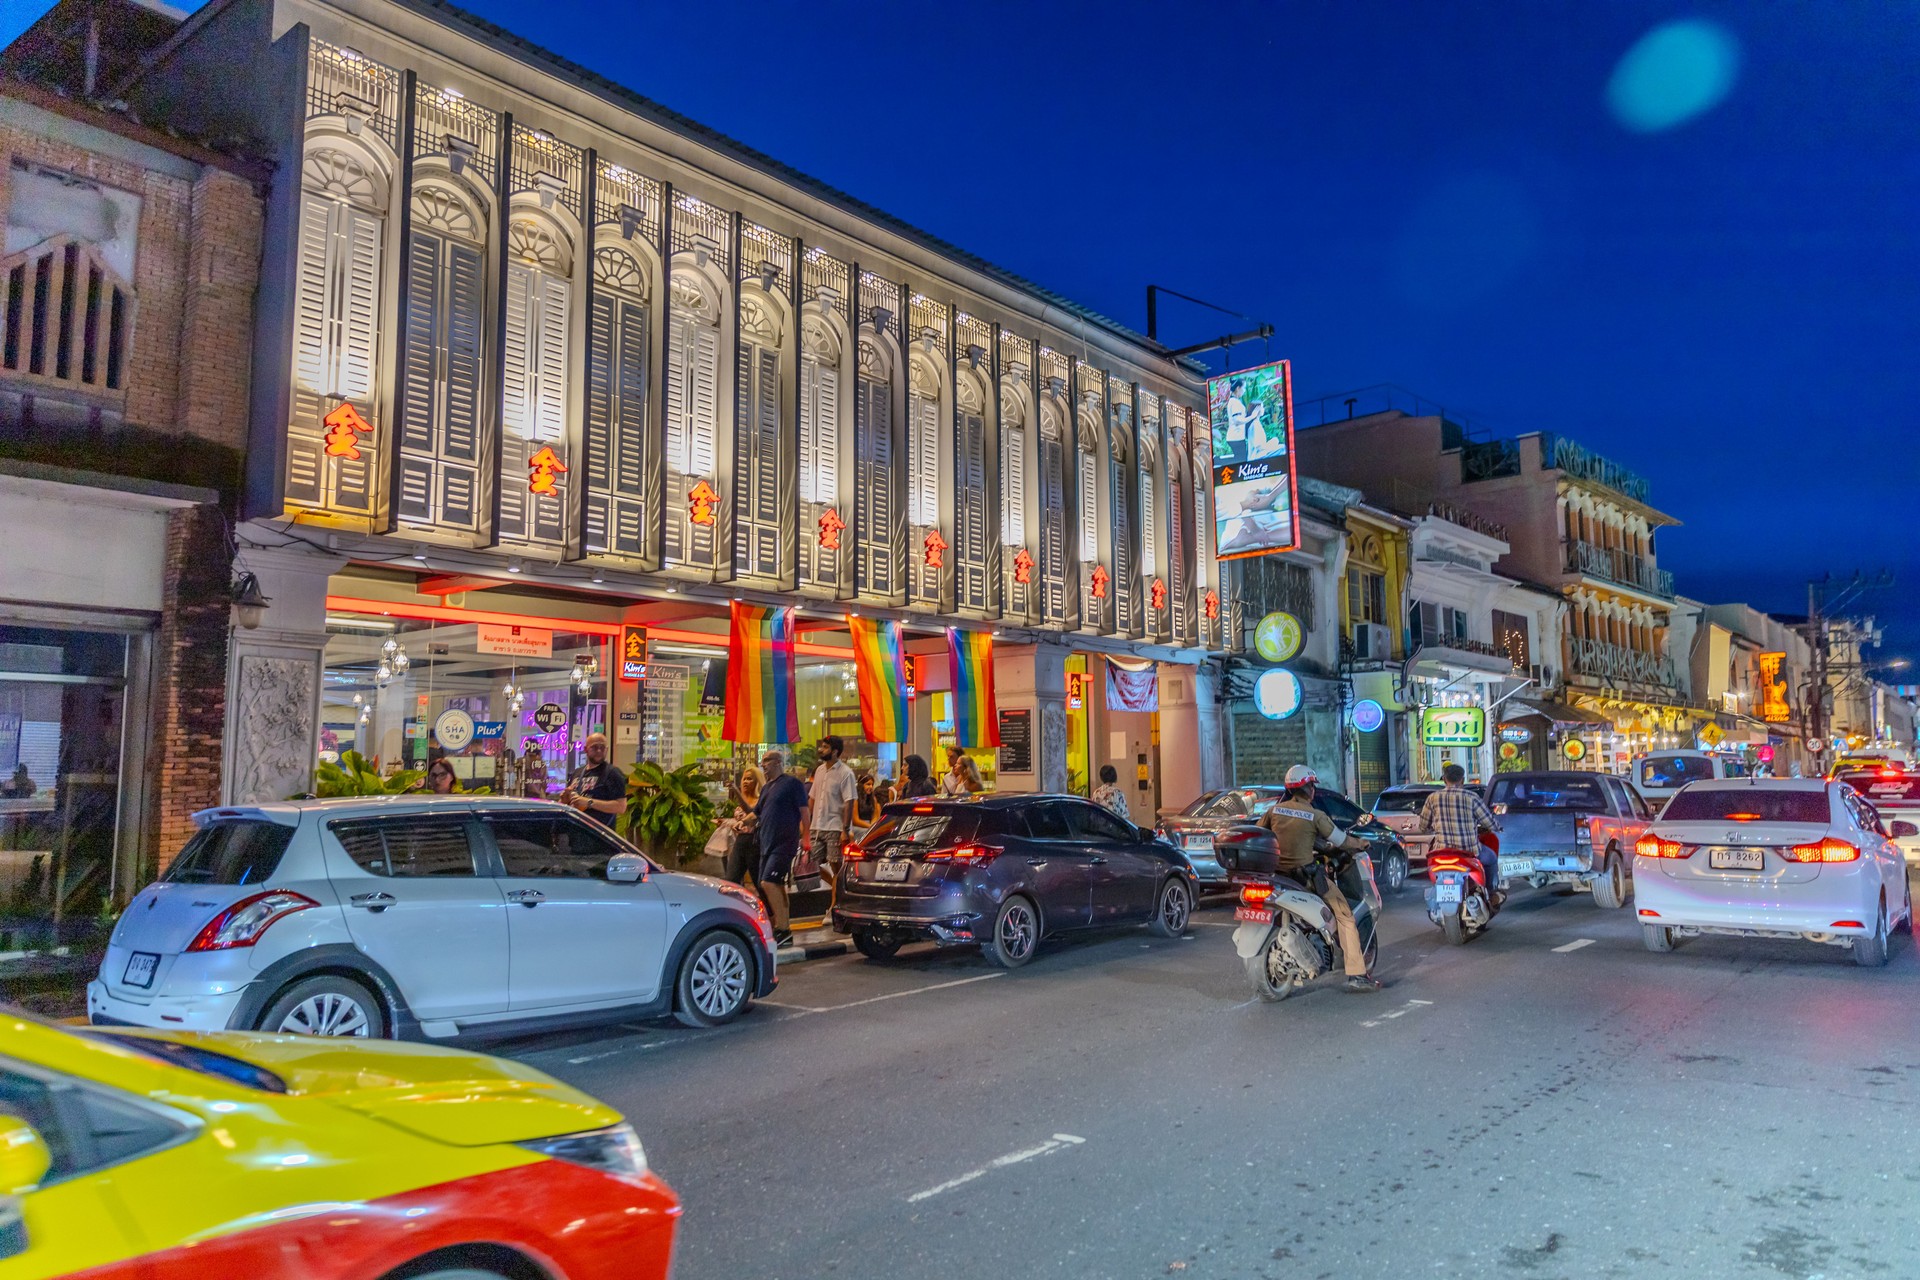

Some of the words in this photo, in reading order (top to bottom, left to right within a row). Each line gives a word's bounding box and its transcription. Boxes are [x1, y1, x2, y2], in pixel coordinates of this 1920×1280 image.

[323, 402, 375, 461] 金
[529, 447, 568, 497] 金
[1238, 463, 1269, 478] Kim's
[688, 480, 720, 526] 金
[818, 508, 846, 550] 金
[924, 529, 948, 568] 金
[626, 632, 645, 658] 金
[624, 661, 646, 673] Kim's
[652, 666, 682, 679] Kim's
[537, 714, 548, 722] Wi
[1808, 741, 1820, 749] 30
[1275, 807, 1293, 816] TRAFFIC
[1294, 811, 1312, 819] POLICE
[1736, 852, 1760, 861] 8262
[1244, 909, 1271, 921] 53464
